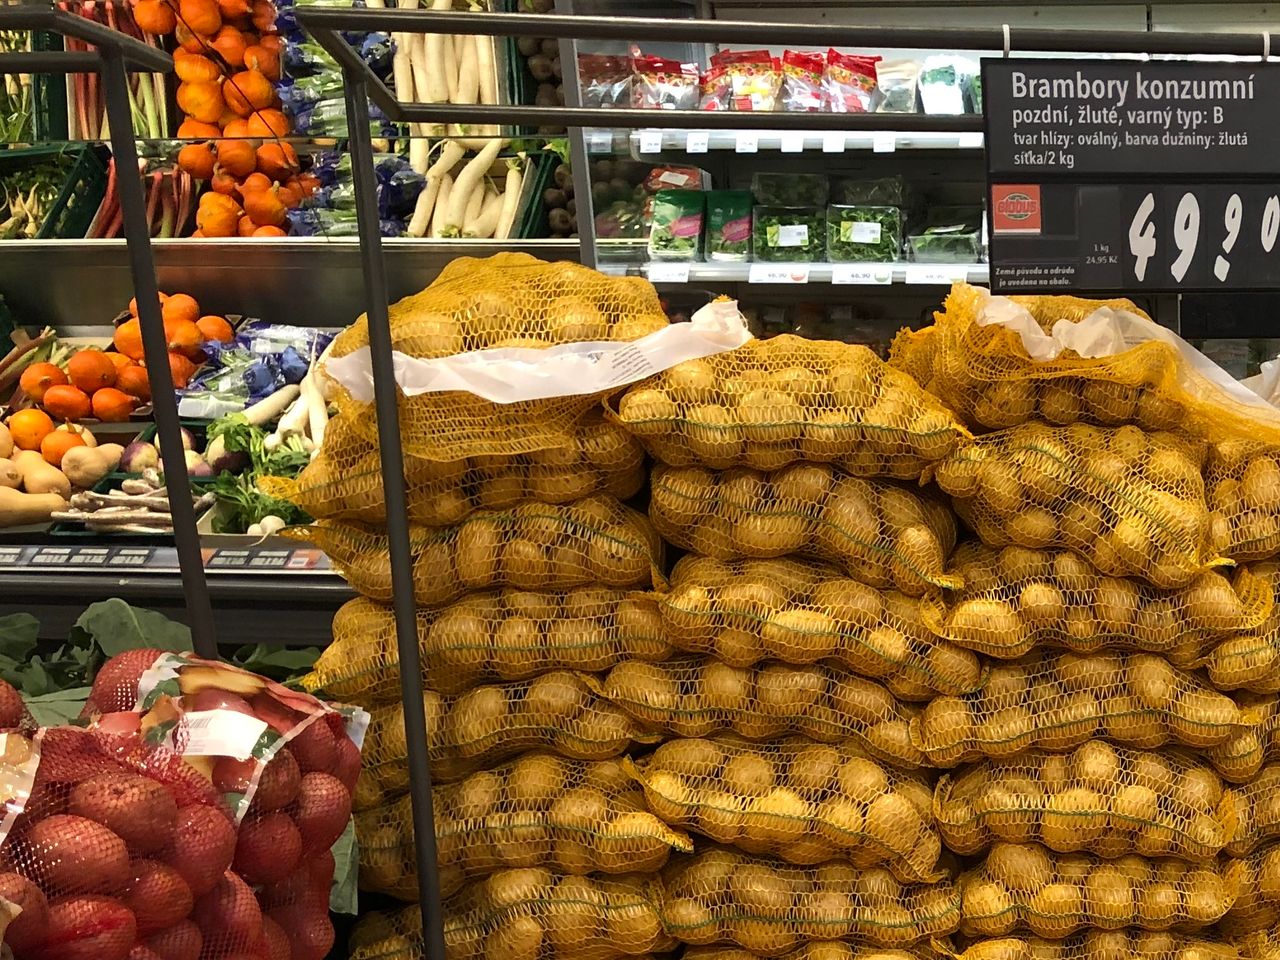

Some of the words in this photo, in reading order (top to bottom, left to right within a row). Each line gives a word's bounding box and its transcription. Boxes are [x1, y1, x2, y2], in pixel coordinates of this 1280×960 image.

[1011, 71, 1130, 107] Brambory
[1136, 72, 1255, 100] konzumní
[1012, 105, 1074, 128] pozdní,
[1077, 104, 1123, 127] žluté,
[1127, 107, 1174, 129] varný
[1176, 108, 1209, 129] typ:
[1213, 108, 1224, 124] B
[1013, 133, 1037, 146] tvar
[1040, 131, 1075, 149] hlízy:
[1077, 131, 1122, 149] oválný,
[1125, 131, 1160, 146] barva
[1162, 131, 1216, 149] dužniny:
[1218, 130, 1249, 146] žlutá
[1056, 151, 1074, 169] kg
